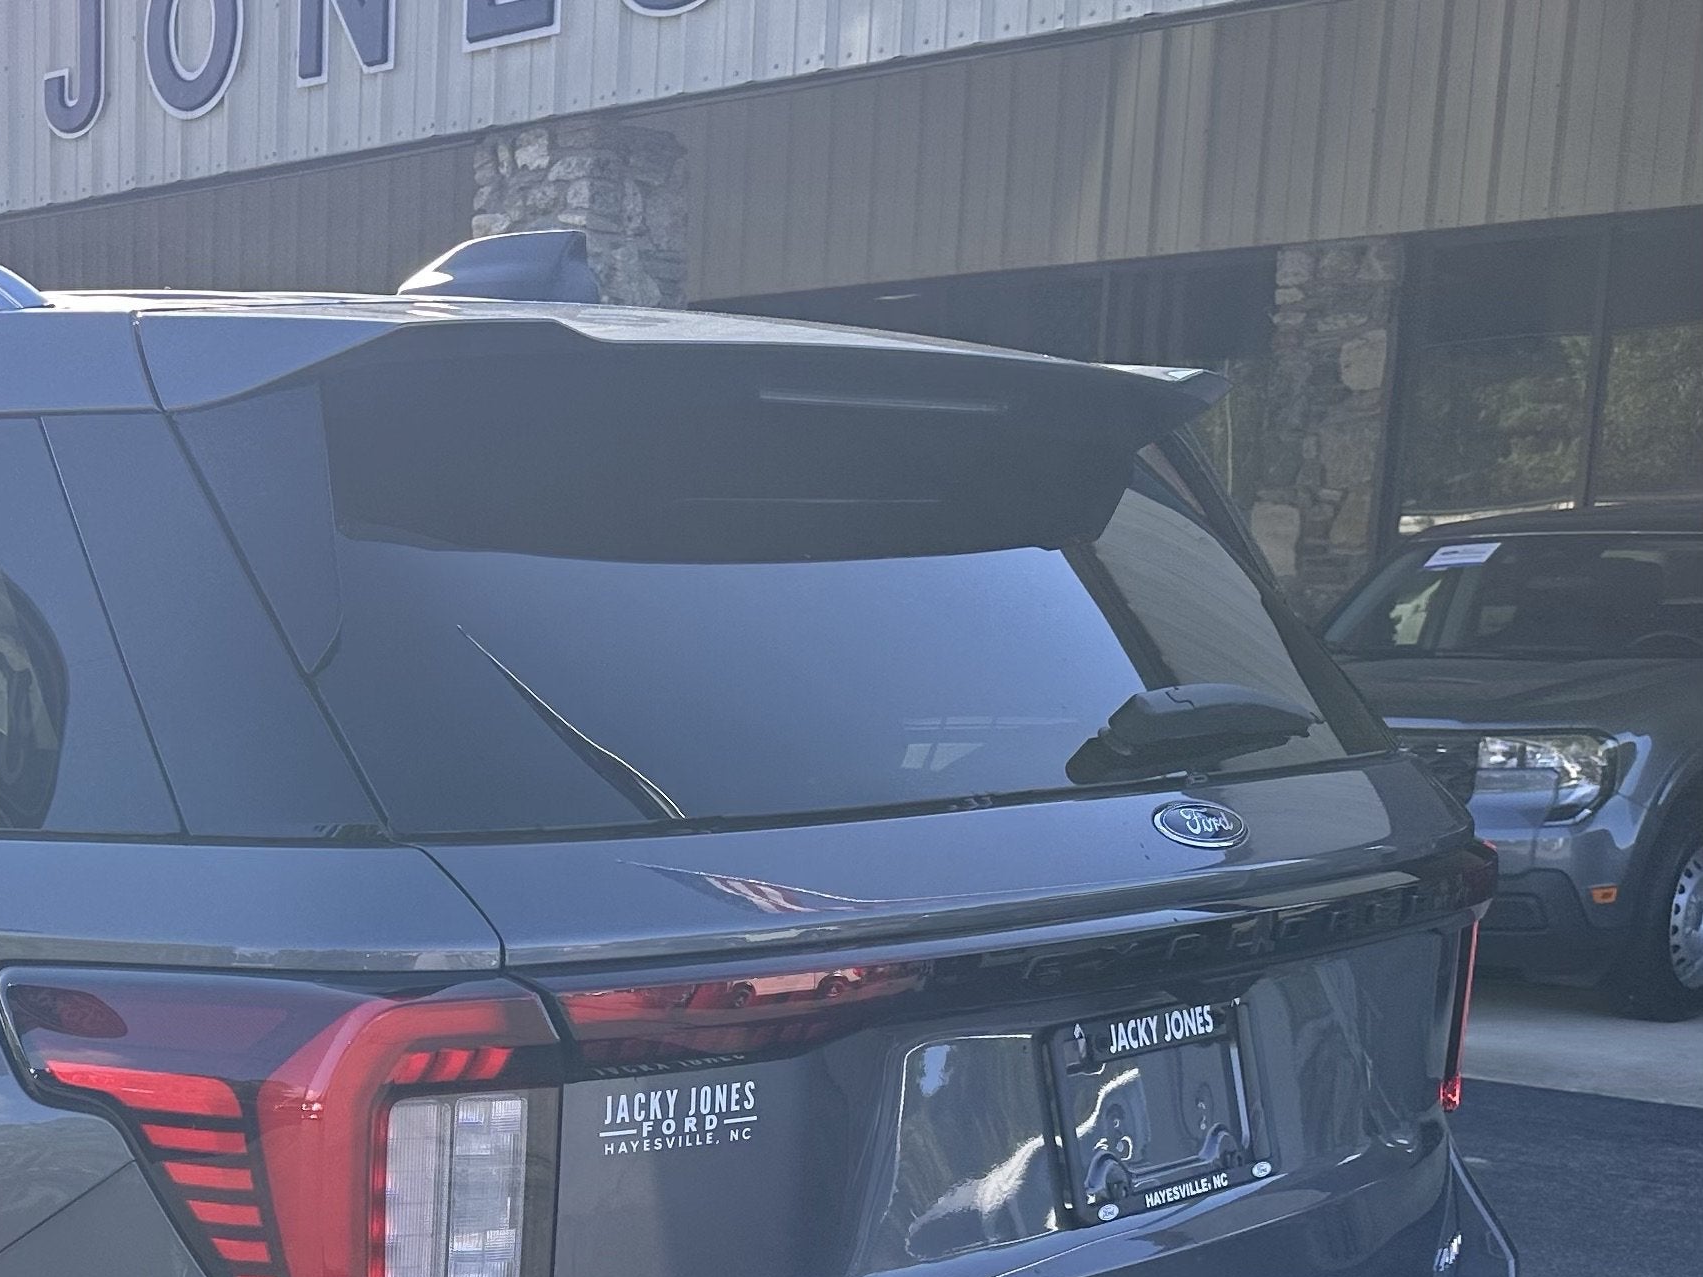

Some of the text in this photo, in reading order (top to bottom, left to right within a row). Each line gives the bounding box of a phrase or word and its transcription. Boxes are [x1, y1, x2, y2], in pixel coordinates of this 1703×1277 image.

[1178, 806, 1235, 836] Ford
[1109, 1004, 1214, 1054] JACKY JONES
[604, 1080, 756, 1125] JACKY JONES
[604, 1127, 752, 1156] HAYESVILLE, NC
[641, 1114, 718, 1138] FORD
[1145, 1173, 1229, 1208] HAYESVILLE, NC
